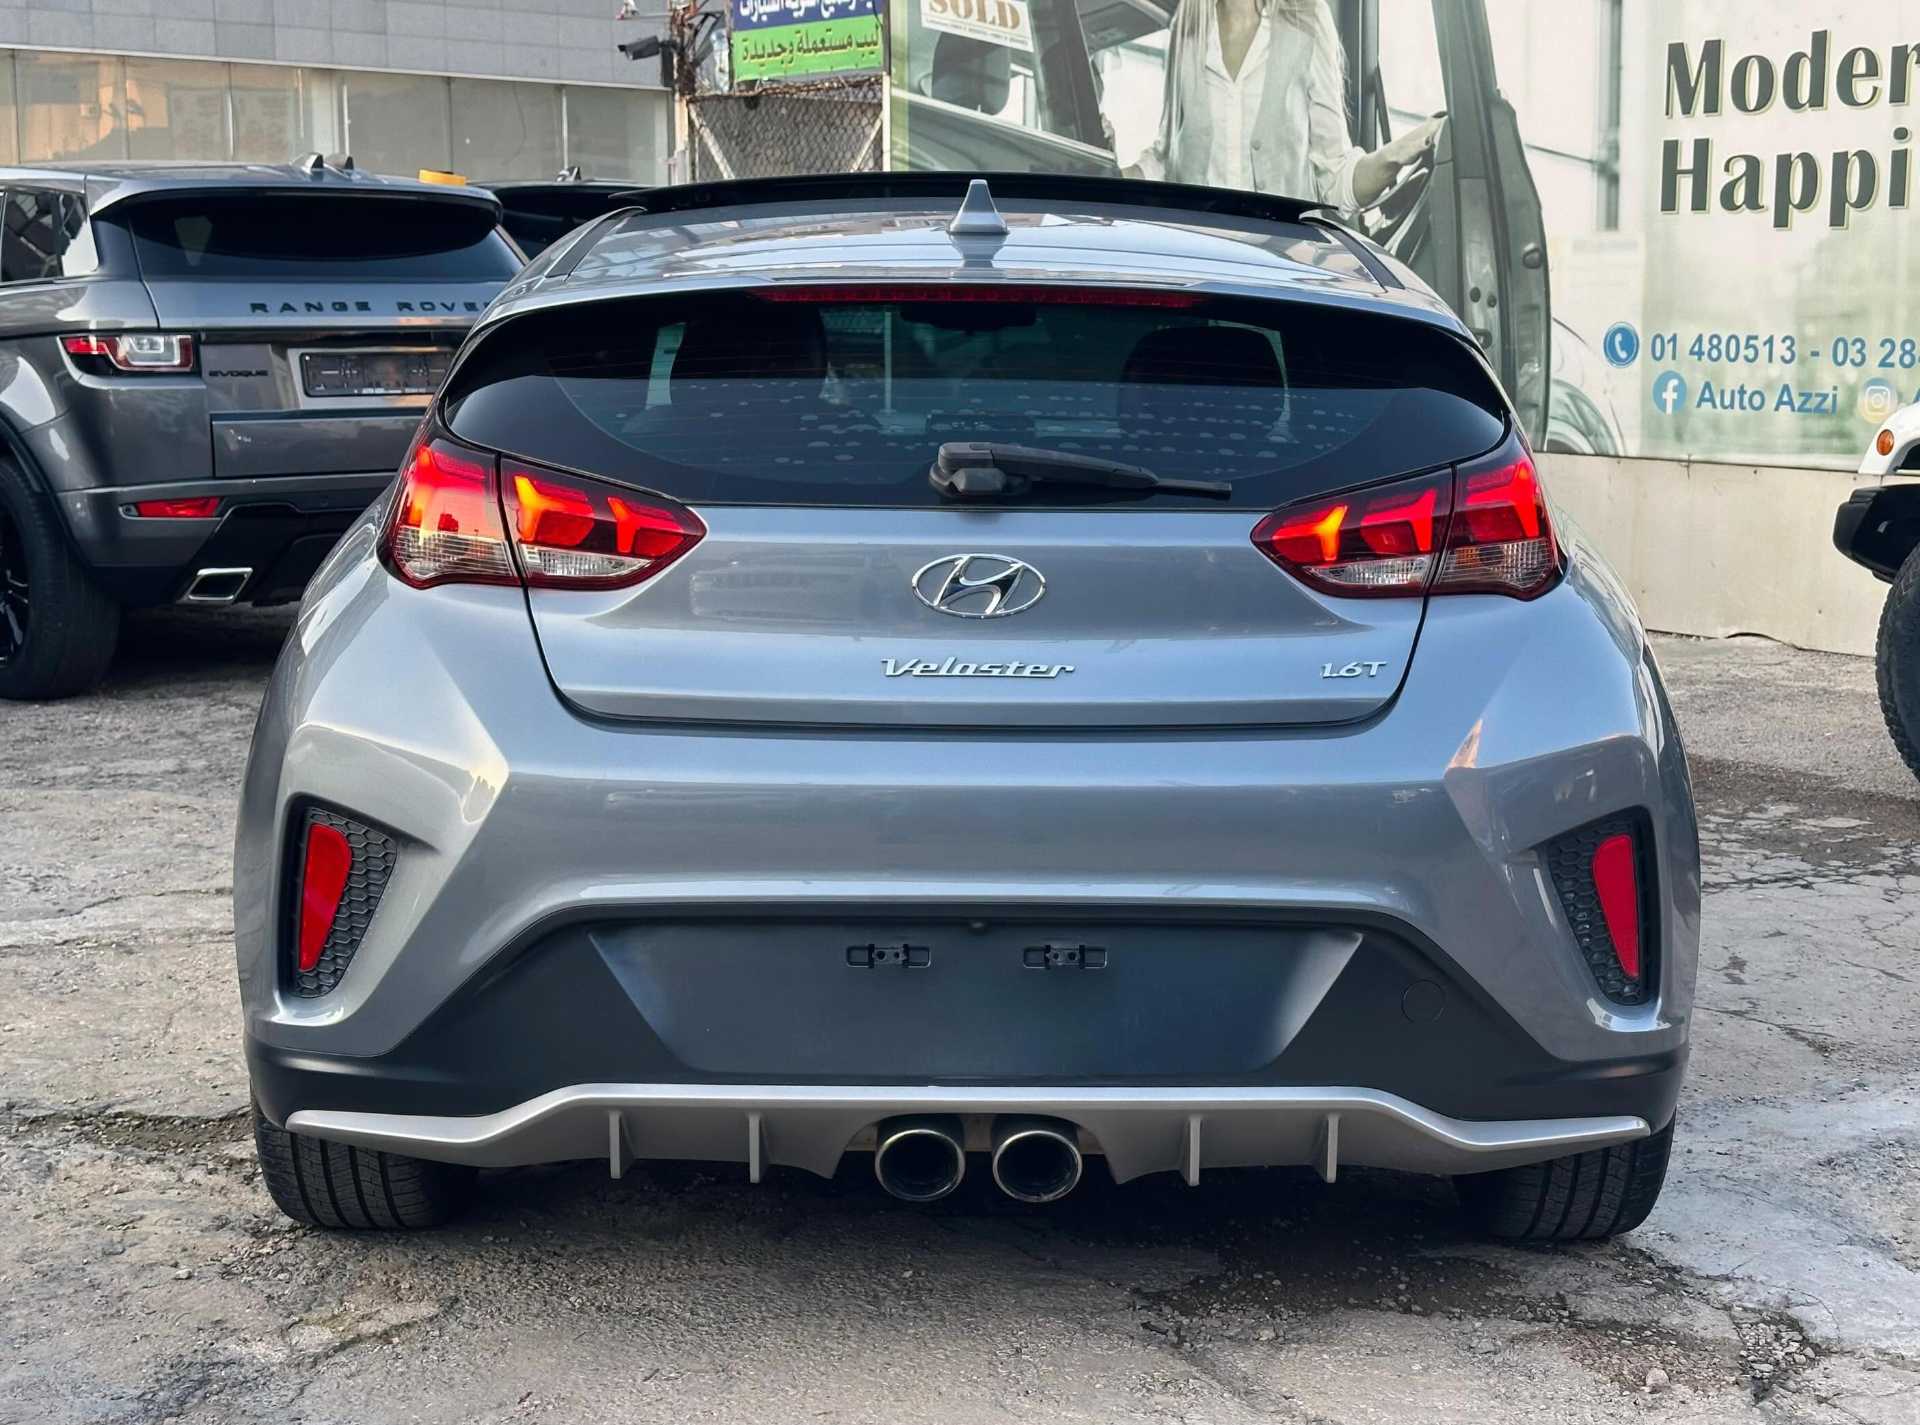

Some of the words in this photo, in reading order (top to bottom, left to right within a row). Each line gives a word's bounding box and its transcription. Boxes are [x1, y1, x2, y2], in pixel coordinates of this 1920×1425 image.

[742, 37, 794, 67] وجديدة
[796, 28, 853, 55] مستعملة
[1664, 29, 1920, 117] Moder
[1660, 126, 1911, 229] Happi
[249, 301, 372, 313] RANGE
[1650, 333, 1678, 361] 01
[1688, 333, 1797, 365] 480513
[1832, 336, 1867, 367] 03
[1878, 338, 1920, 369] 28
[208, 369, 269, 377] EVOQUE
[1696, 381, 1766, 412] Auto
[1774, 384, 1838, 415] Azzi
[880, 656, 1075, 679] Veloster
